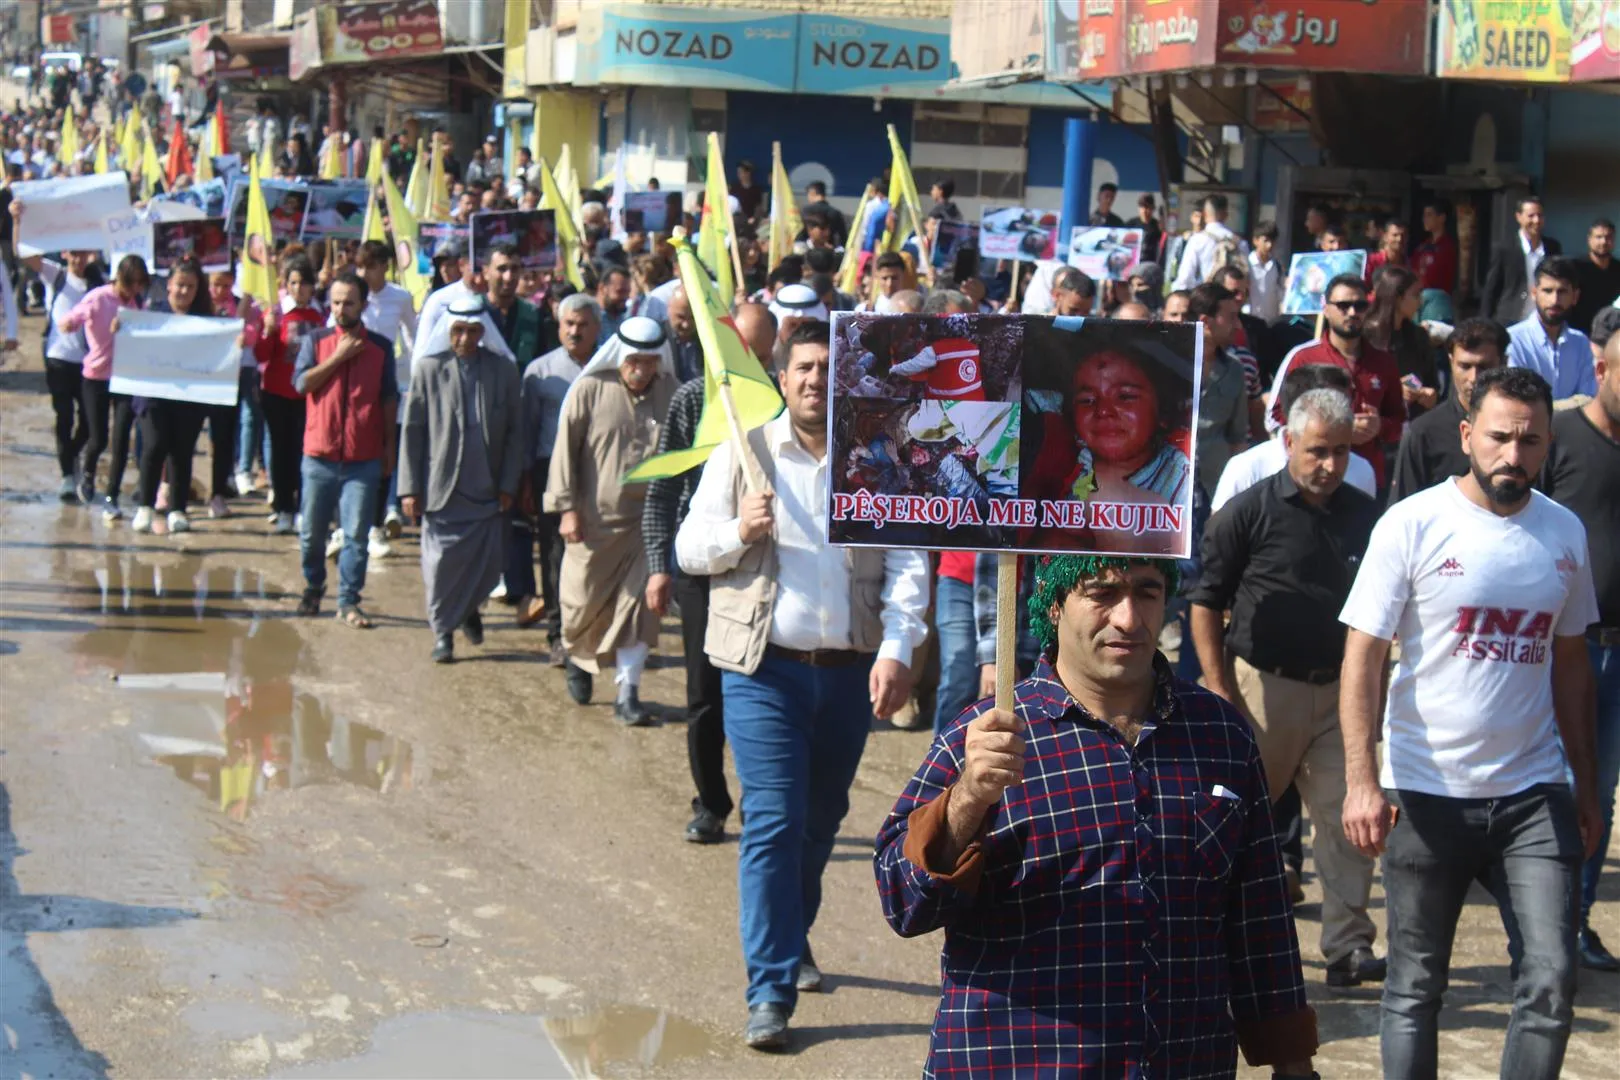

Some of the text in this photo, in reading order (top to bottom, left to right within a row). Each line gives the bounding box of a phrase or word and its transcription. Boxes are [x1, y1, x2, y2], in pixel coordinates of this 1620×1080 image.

[811, 24, 865, 36] STUDIO
[1154, 7, 1198, 51] مطعم
[1291, 9, 1338, 45] روز
[615, 29, 733, 60] NOZAD
[813, 41, 940, 70] NOZAD
[1484, 29, 1550, 68] SAEED
[832, 488, 1184, 536] PÊŞEROJA ME NE KUJIN
[1453, 606, 1554, 640] INA
[1452, 634, 1546, 665] Assitalia
